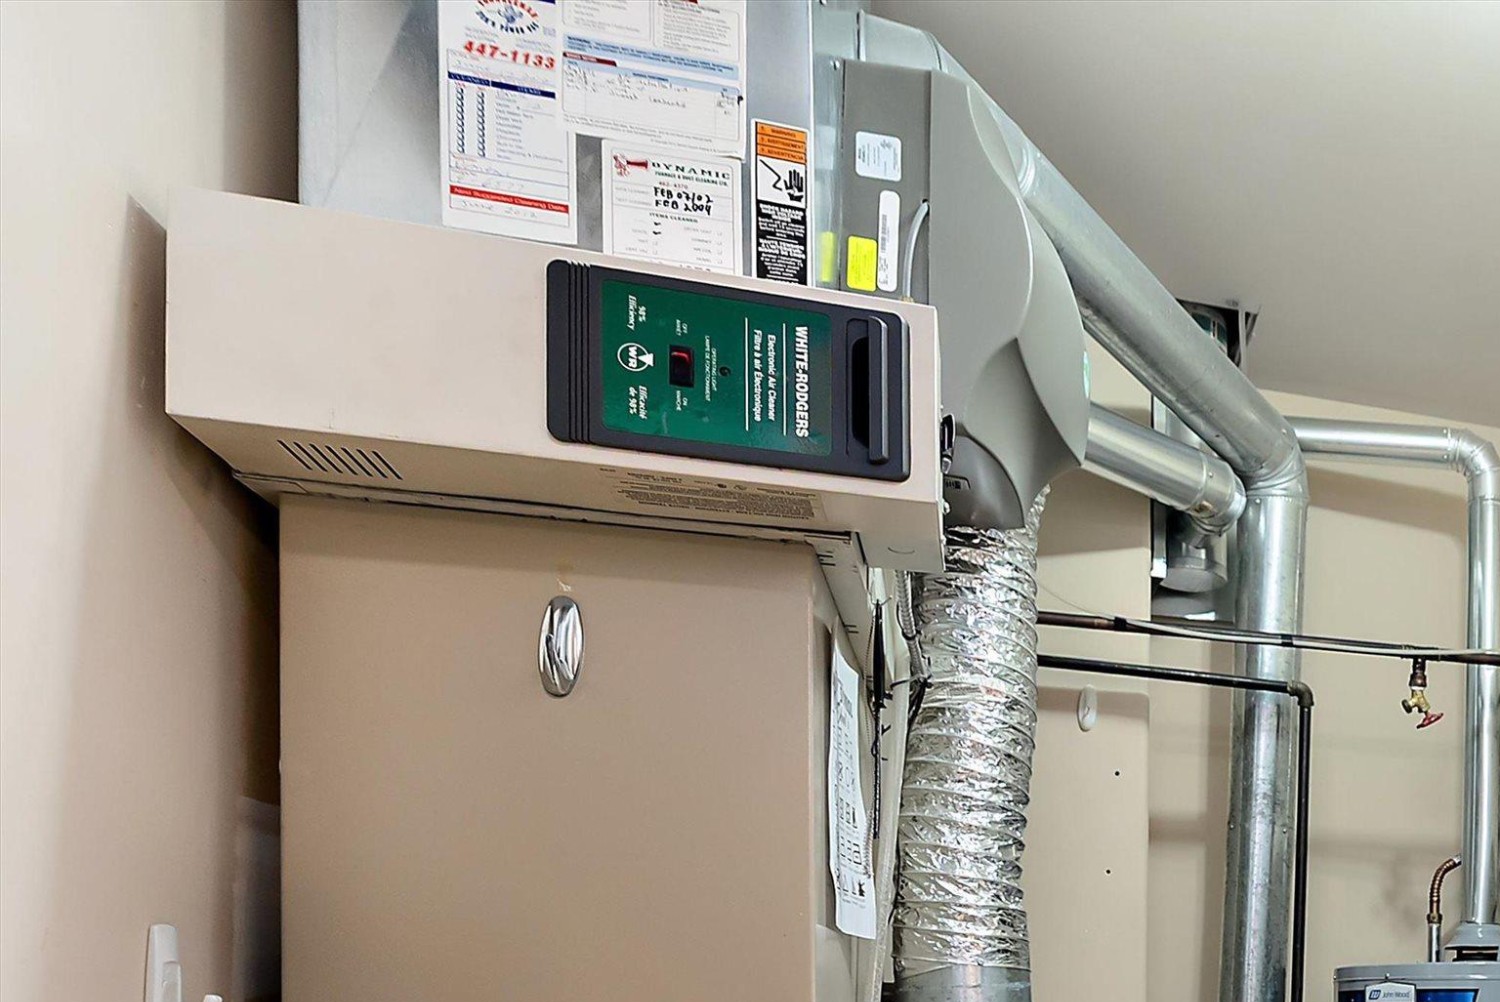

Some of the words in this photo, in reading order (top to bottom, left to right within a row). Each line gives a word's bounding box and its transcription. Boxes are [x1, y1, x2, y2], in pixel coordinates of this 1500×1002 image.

[464, 41, 556, 70] 447-1133
[652, 161, 731, 180] DYNAMIC
[653, 186, 674, 200] FEB
[683, 202, 712, 216] 2004
[754, 329, 763, 352] Filtre
[754, 358, 763, 370] air
[767, 334, 777, 375] Electronic
[768, 376, 777, 389] Air
[795, 326, 809, 438] WHITE-RODGERS
[768, 390, 777, 421] Cleaner
